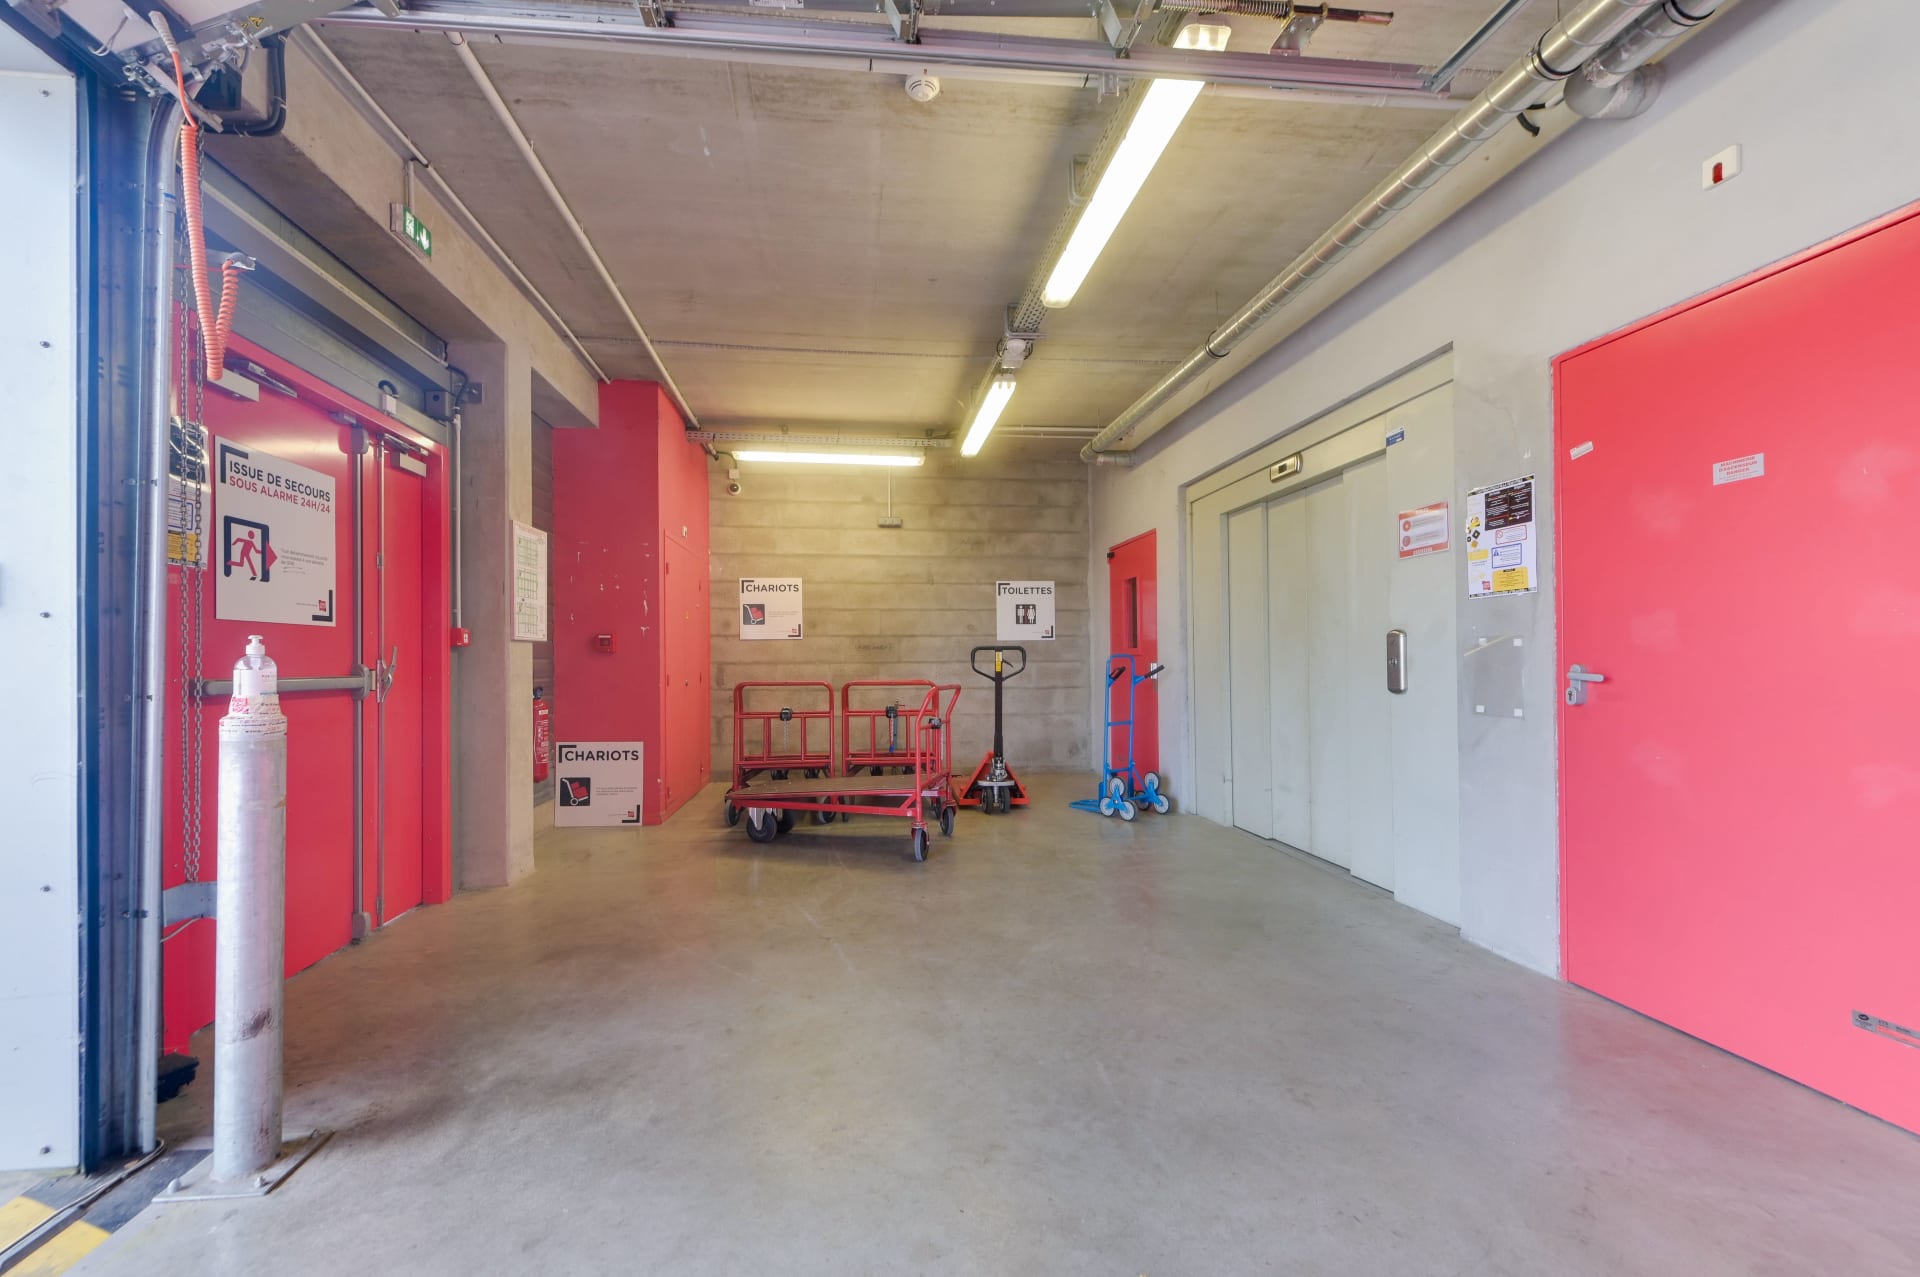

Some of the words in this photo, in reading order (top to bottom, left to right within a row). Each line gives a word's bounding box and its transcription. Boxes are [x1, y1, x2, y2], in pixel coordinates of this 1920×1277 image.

[229, 460, 264, 482] ISSUE
[267, 472, 282, 488] DE
[284, 479, 331, 502] SECOURS
[229, 476, 258, 493] SOUS
[260, 485, 299, 505] ALARME
[300, 497, 331, 514] 24H/24
[745, 584, 800, 593] CHARIOTS
[1001, 586, 1053, 595] TOILETTES
[564, 750, 640, 761] CHARIOTS
